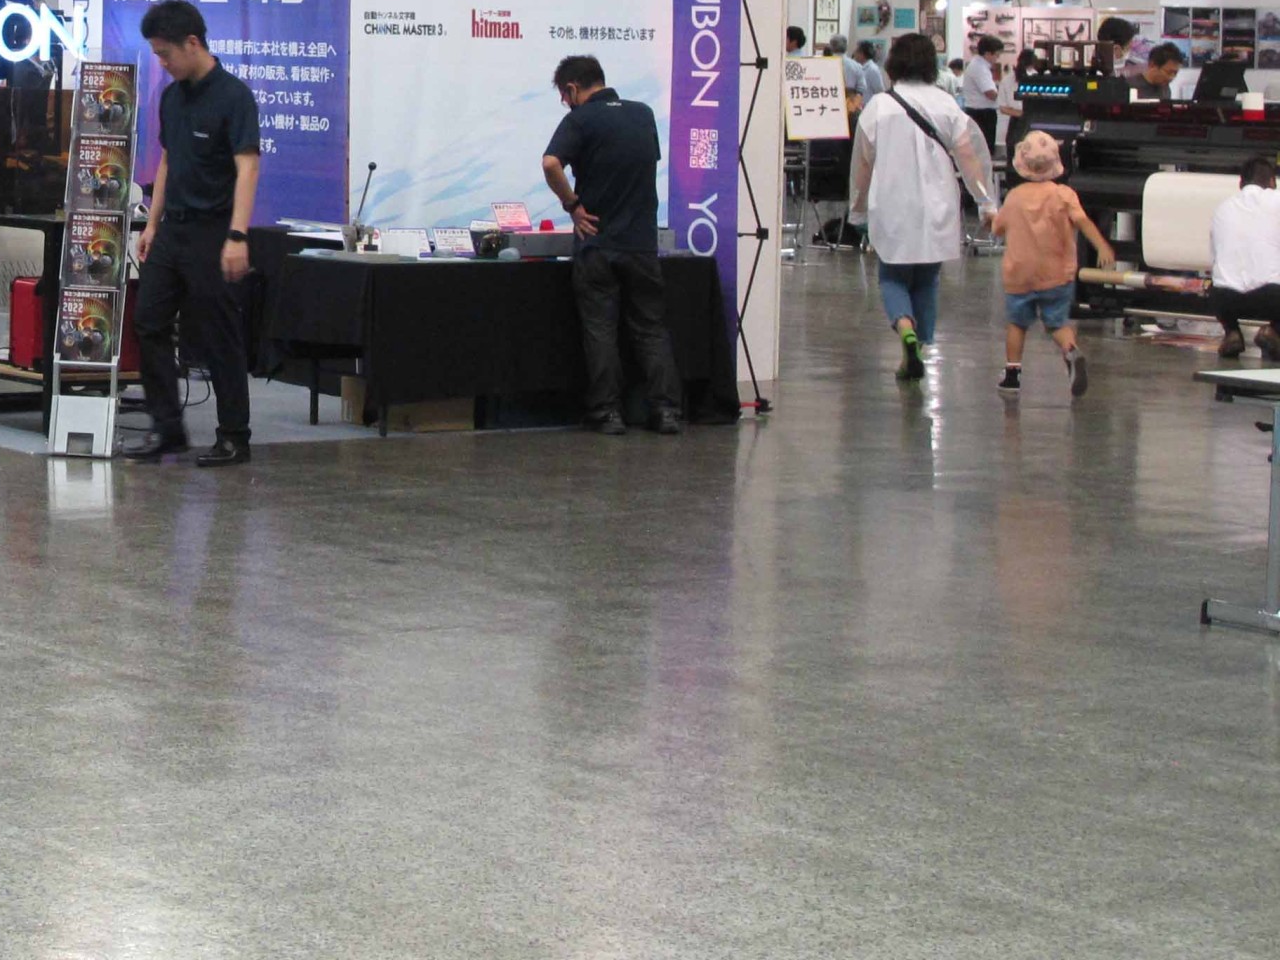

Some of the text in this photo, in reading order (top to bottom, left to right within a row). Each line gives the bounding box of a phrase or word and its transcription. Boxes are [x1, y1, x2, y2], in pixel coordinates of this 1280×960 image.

[364, 23, 444, 36] CHANNEL MASTER 3
[549, 25, 656, 41] その他、機材多数ございます
[83, 75, 105, 86] 2022
[790, 85, 839, 99] 打ち合わせ
[793, 104, 840, 116] コーナー
[79, 150, 101, 160] 2022
[72, 225, 94, 236] 2022
[687, 192, 718, 257] YO
[62, 302, 84, 313] 2022
